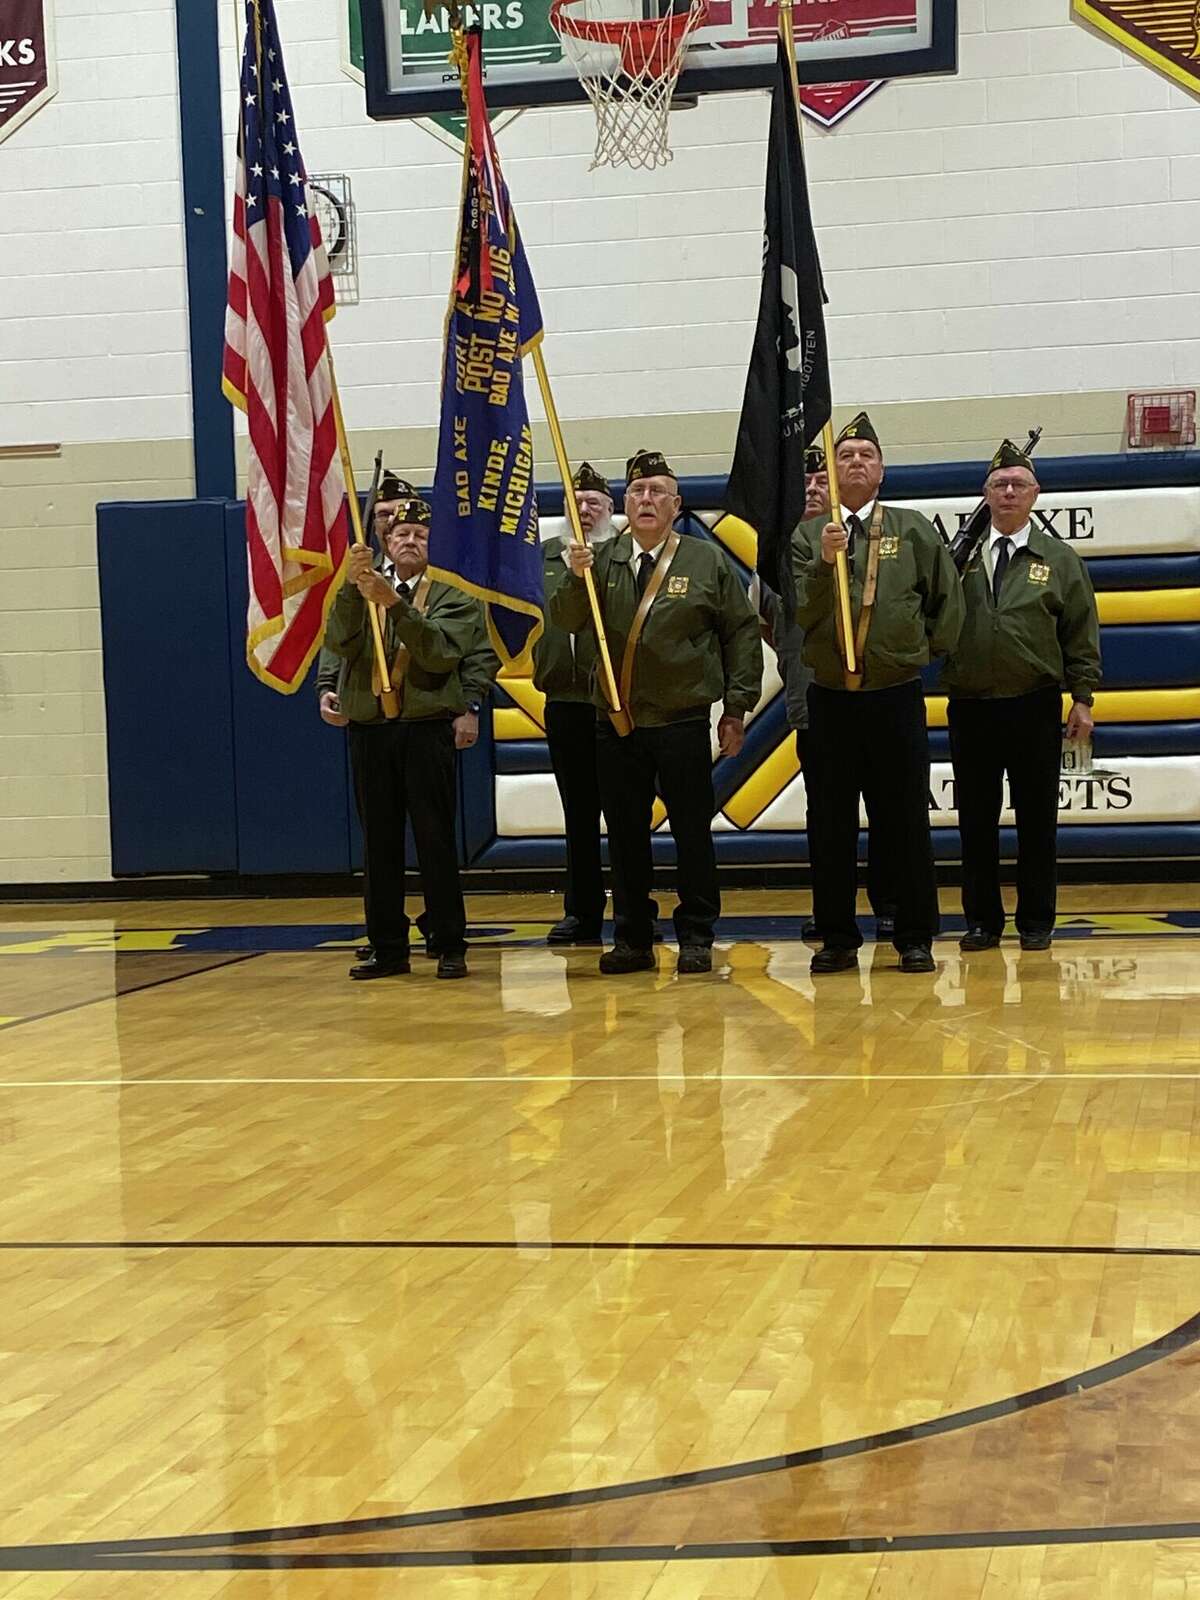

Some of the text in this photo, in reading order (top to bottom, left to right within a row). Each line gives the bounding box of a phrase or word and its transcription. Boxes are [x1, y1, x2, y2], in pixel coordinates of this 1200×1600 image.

[488, 245, 512, 281] 116
[473, 290, 507, 323] NO
[463, 332, 497, 394] POST
[488, 302, 520, 407] BAD AXE MI
[454, 415, 472, 517] BAD AXE
[477, 435, 513, 512] KINDE,
[499, 423, 532, 536] MICHIGAN
[1031, 506, 1095, 540] XE
